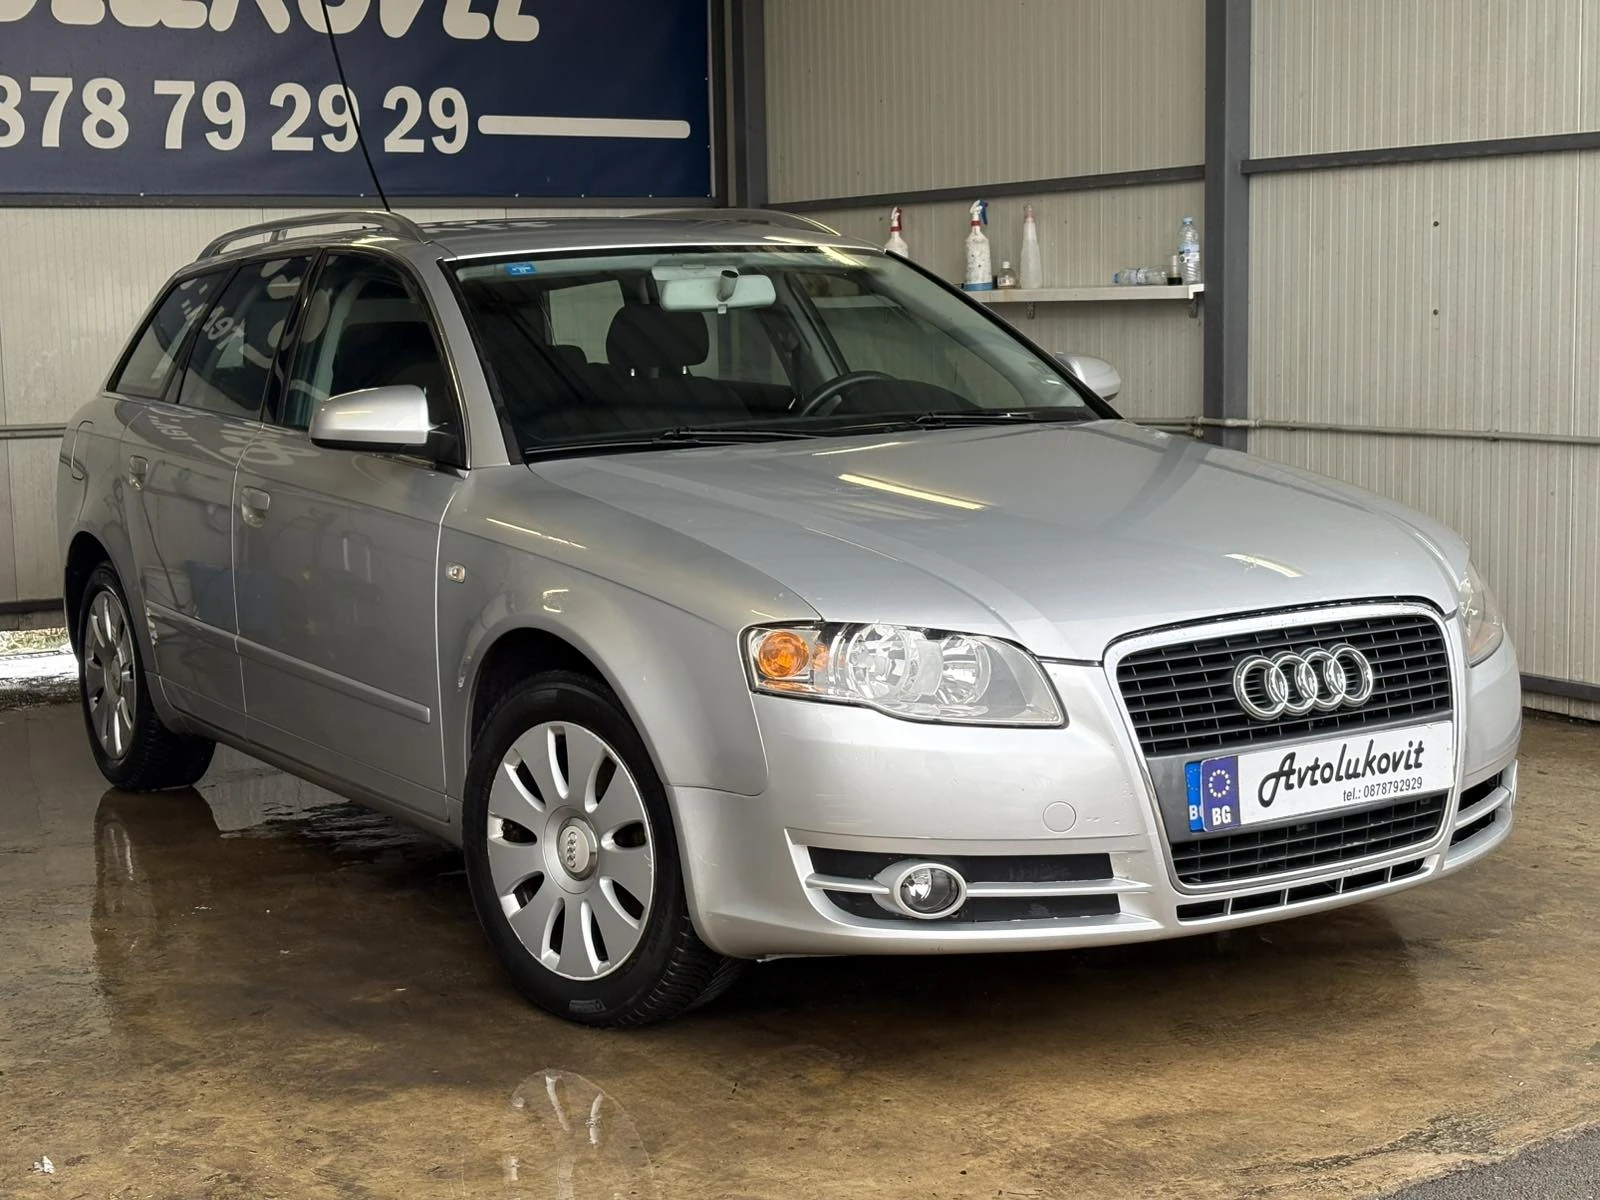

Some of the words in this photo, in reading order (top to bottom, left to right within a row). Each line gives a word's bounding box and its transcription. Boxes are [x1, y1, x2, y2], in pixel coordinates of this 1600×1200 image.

[154, 80, 245, 150] 79
[270, 83, 360, 152] 29
[383, 86, 468, 153] 29
[1258, 739, 1425, 808] Avtolukovit
[1343, 788, 1361, 803] tel.:
[1363, 776, 1424, 799] 0878792929
[1189, 804, 1204, 821] B
[1211, 804, 1232, 826] BG
